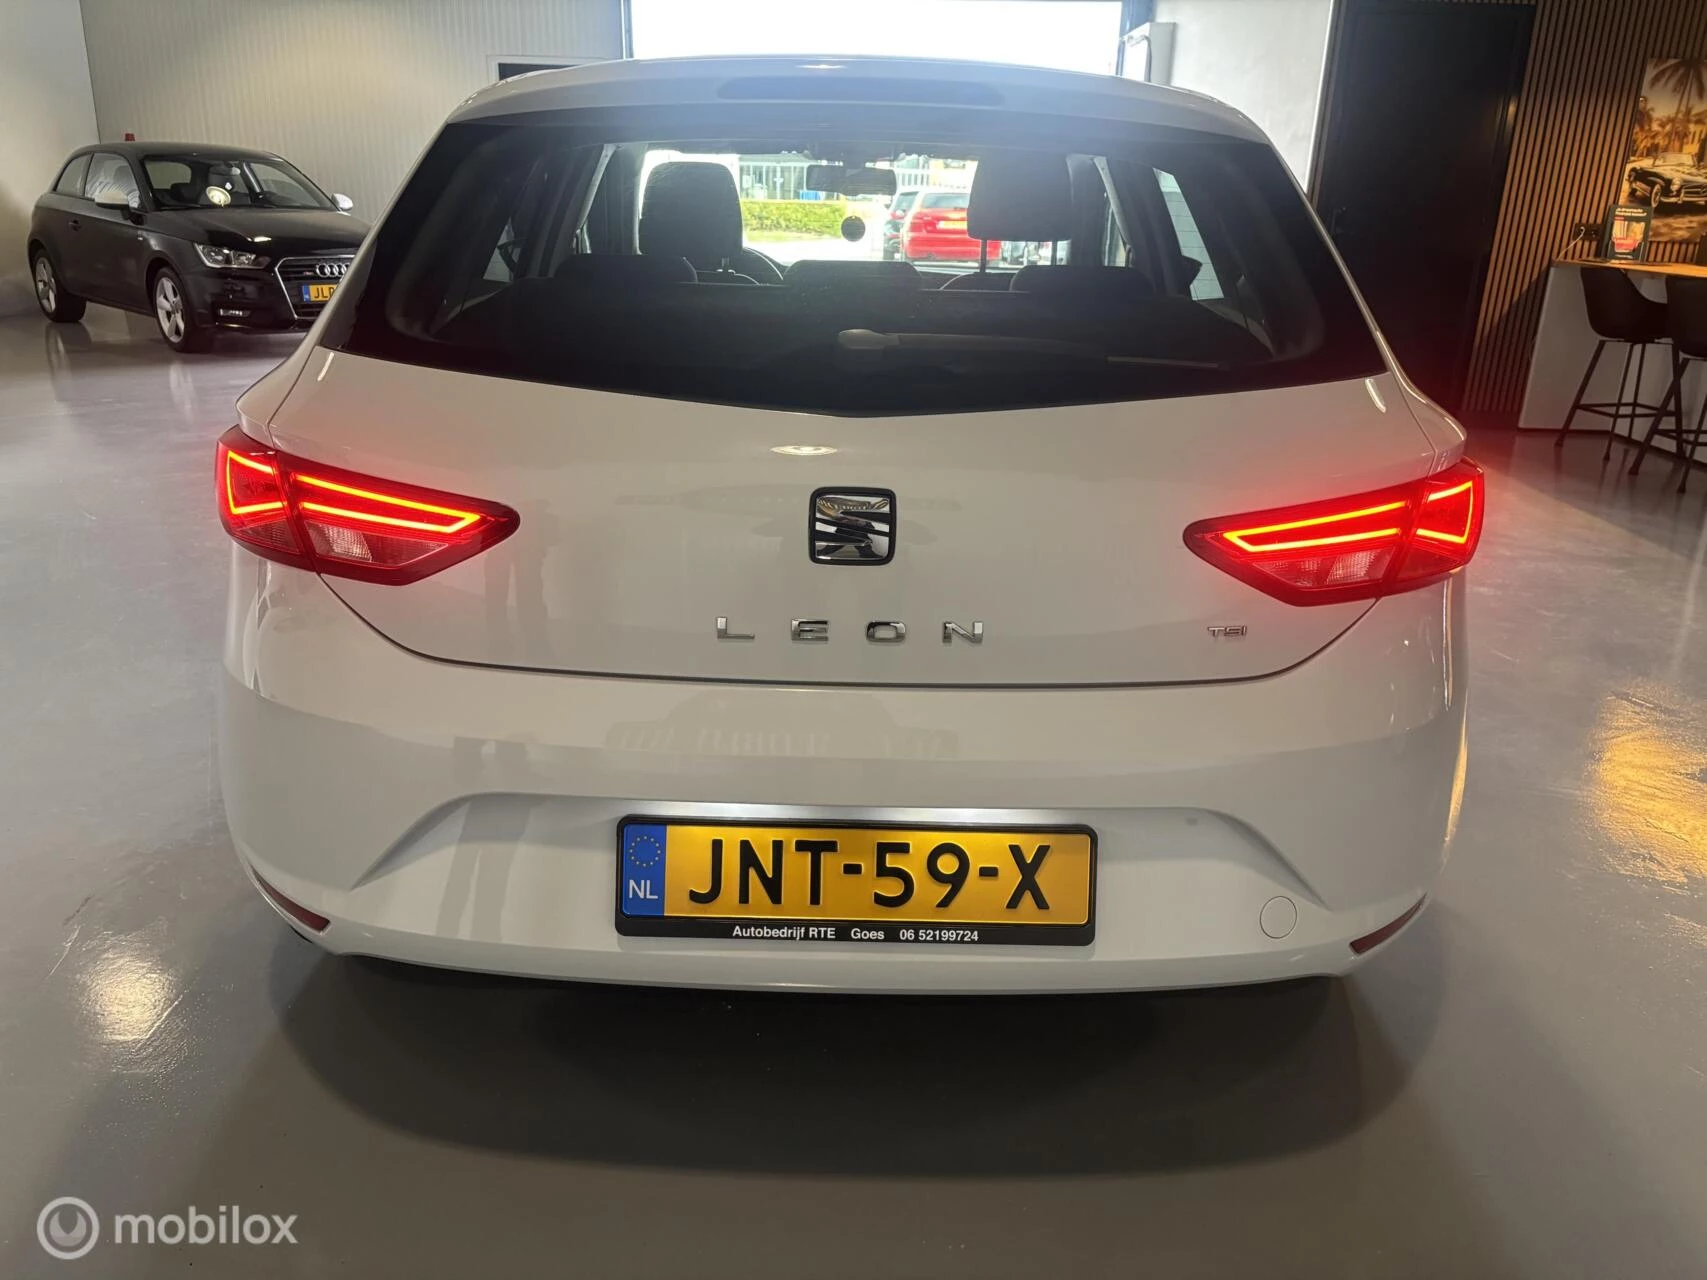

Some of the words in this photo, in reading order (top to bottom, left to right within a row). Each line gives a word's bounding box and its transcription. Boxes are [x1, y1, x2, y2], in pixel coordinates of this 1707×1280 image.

[715, 616, 985, 645] LEON
[1207, 625, 1248, 638] TSI
[688, 838, 1051, 911] JNT-59-X
[628, 879, 658, 900] NL
[732, 925, 806, 941] Autobedrijf
[808, 927, 836, 940] RTE
[850, 928, 885, 942] Goes
[899, 929, 916, 941] 06
[918, 929, 979, 942] 52199724
